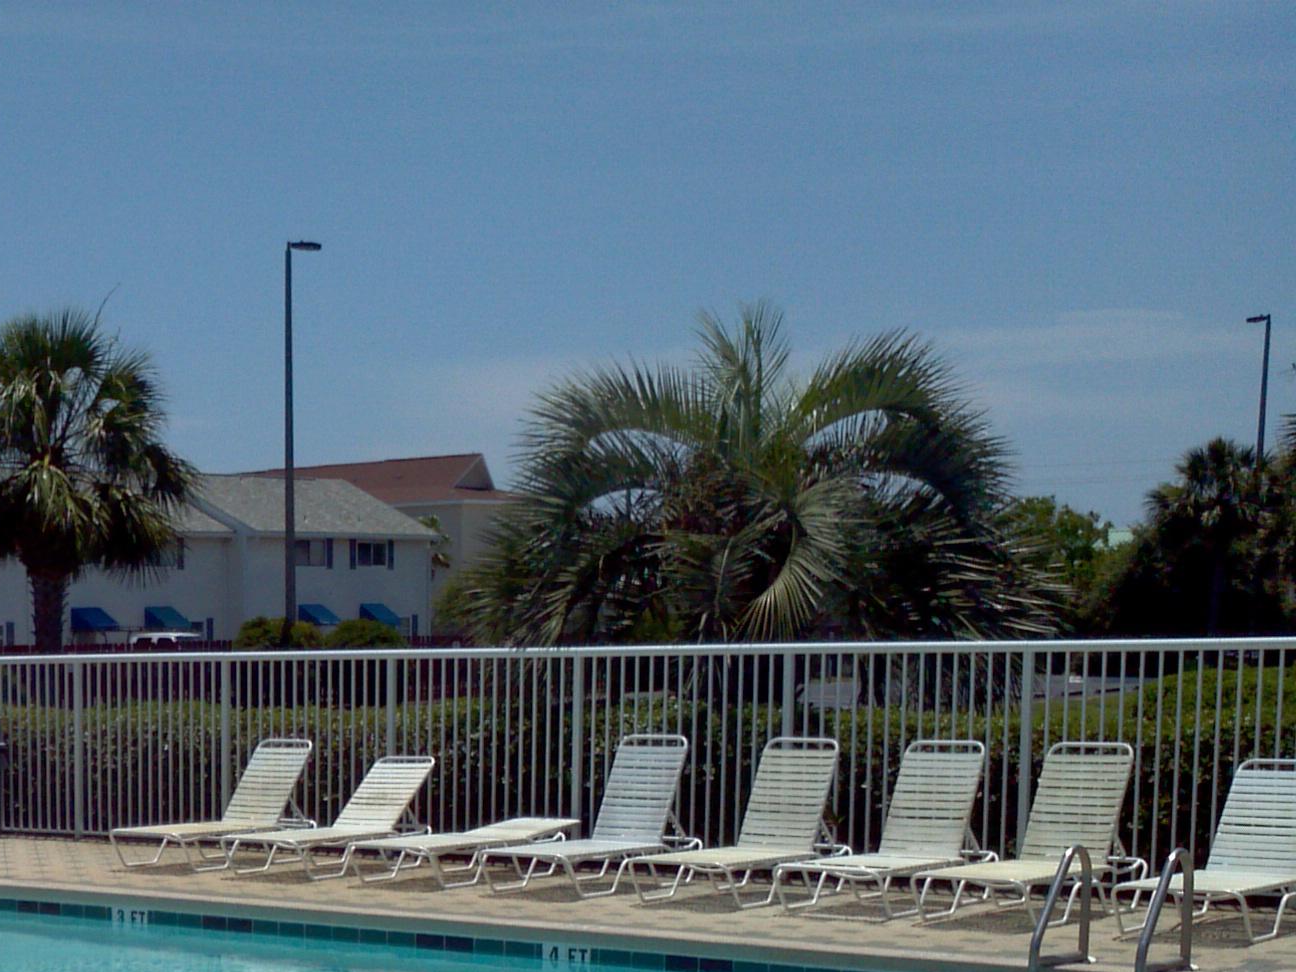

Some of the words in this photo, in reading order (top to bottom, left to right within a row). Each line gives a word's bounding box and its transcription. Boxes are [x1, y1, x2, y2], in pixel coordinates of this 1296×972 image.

[131, 910, 146, 926] FT
[549, 946, 559, 961] 4
[567, 948, 588, 963] FT
